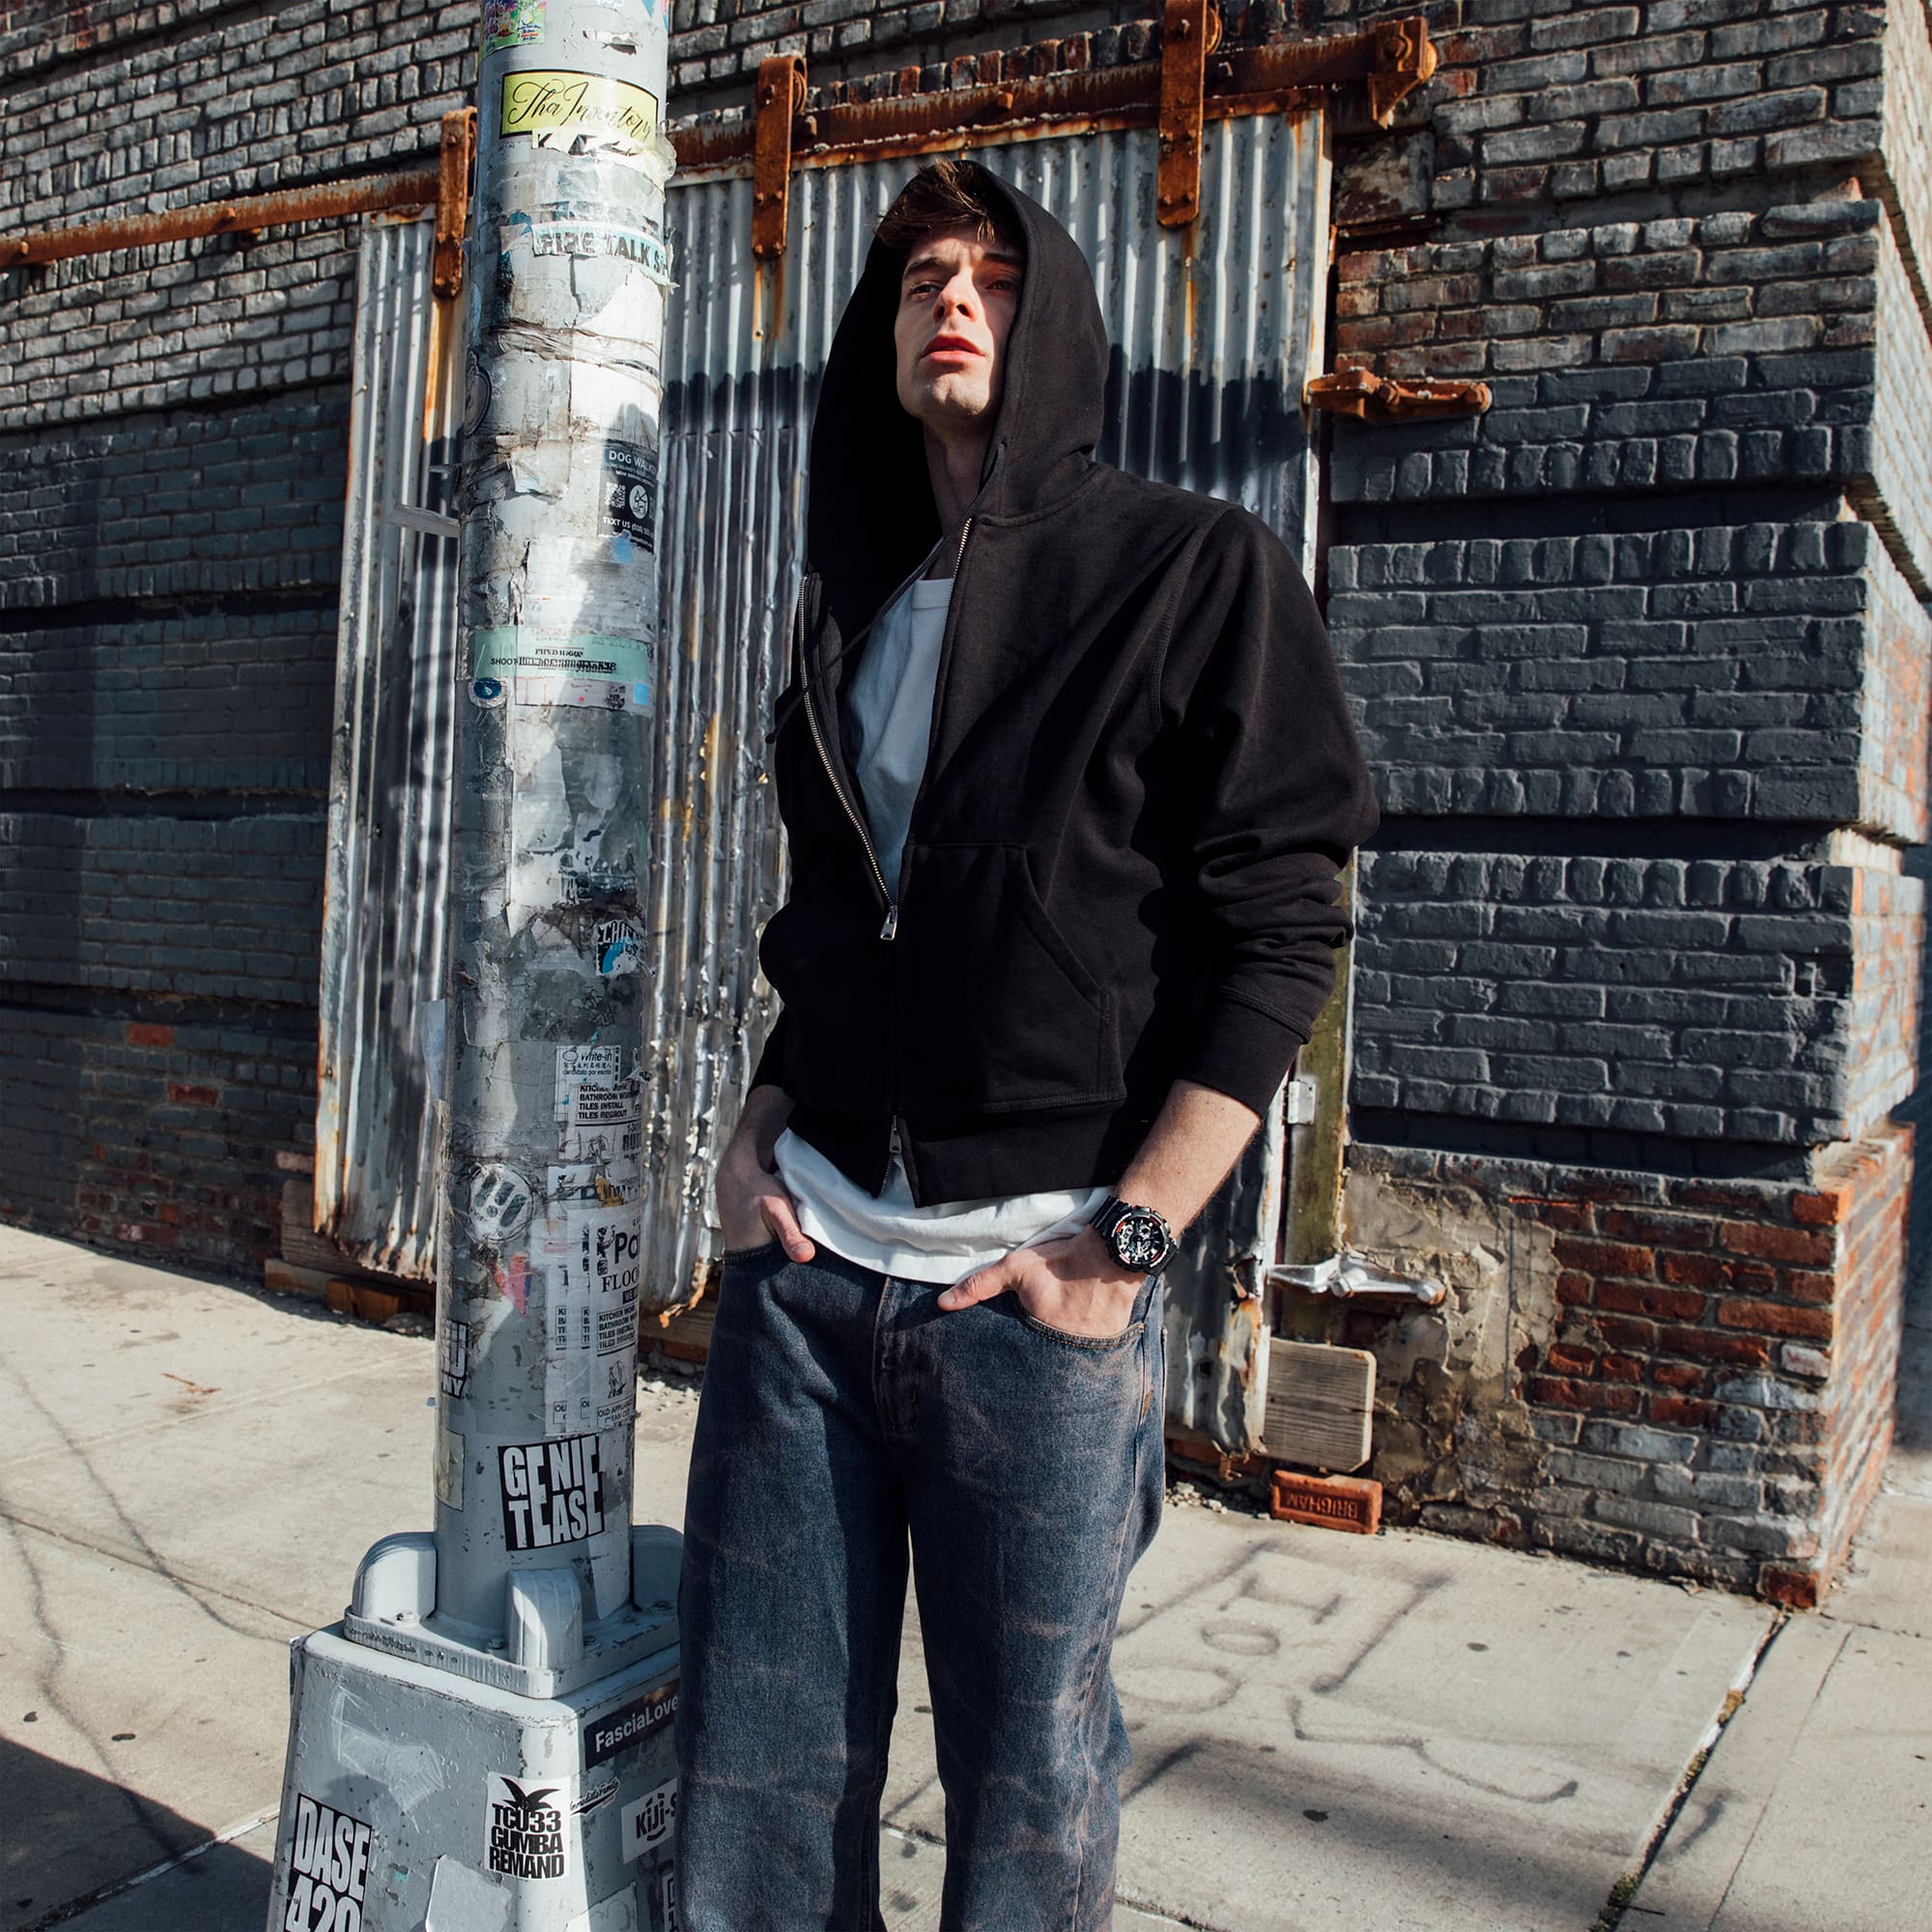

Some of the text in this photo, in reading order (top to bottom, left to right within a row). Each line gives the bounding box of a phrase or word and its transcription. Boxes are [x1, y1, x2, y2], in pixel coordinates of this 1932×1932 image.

[609, 450, 632, 464] DOG
[602, 517, 621, 526] TEXT
[622, 520, 631, 528] US
[581, 1051, 612, 1061] Write-in
[600, 1101, 624, 1110] INSTALL
[600, 1110, 628, 1119] REGROUT
[599, 1309, 623, 1322] KITCHEN
[600, 1330, 615, 1340] TILES
[598, 1407, 611, 1417] OLD
[503, 1435, 600, 1496] GENIE
[508, 1490, 603, 1548] TEASE
[492, 1803, 561, 1833] TCU33
[491, 1825, 564, 1855] GUMBA
[293, 1797, 371, 1902] DASE
[490, 1845, 565, 1879] REMAND
